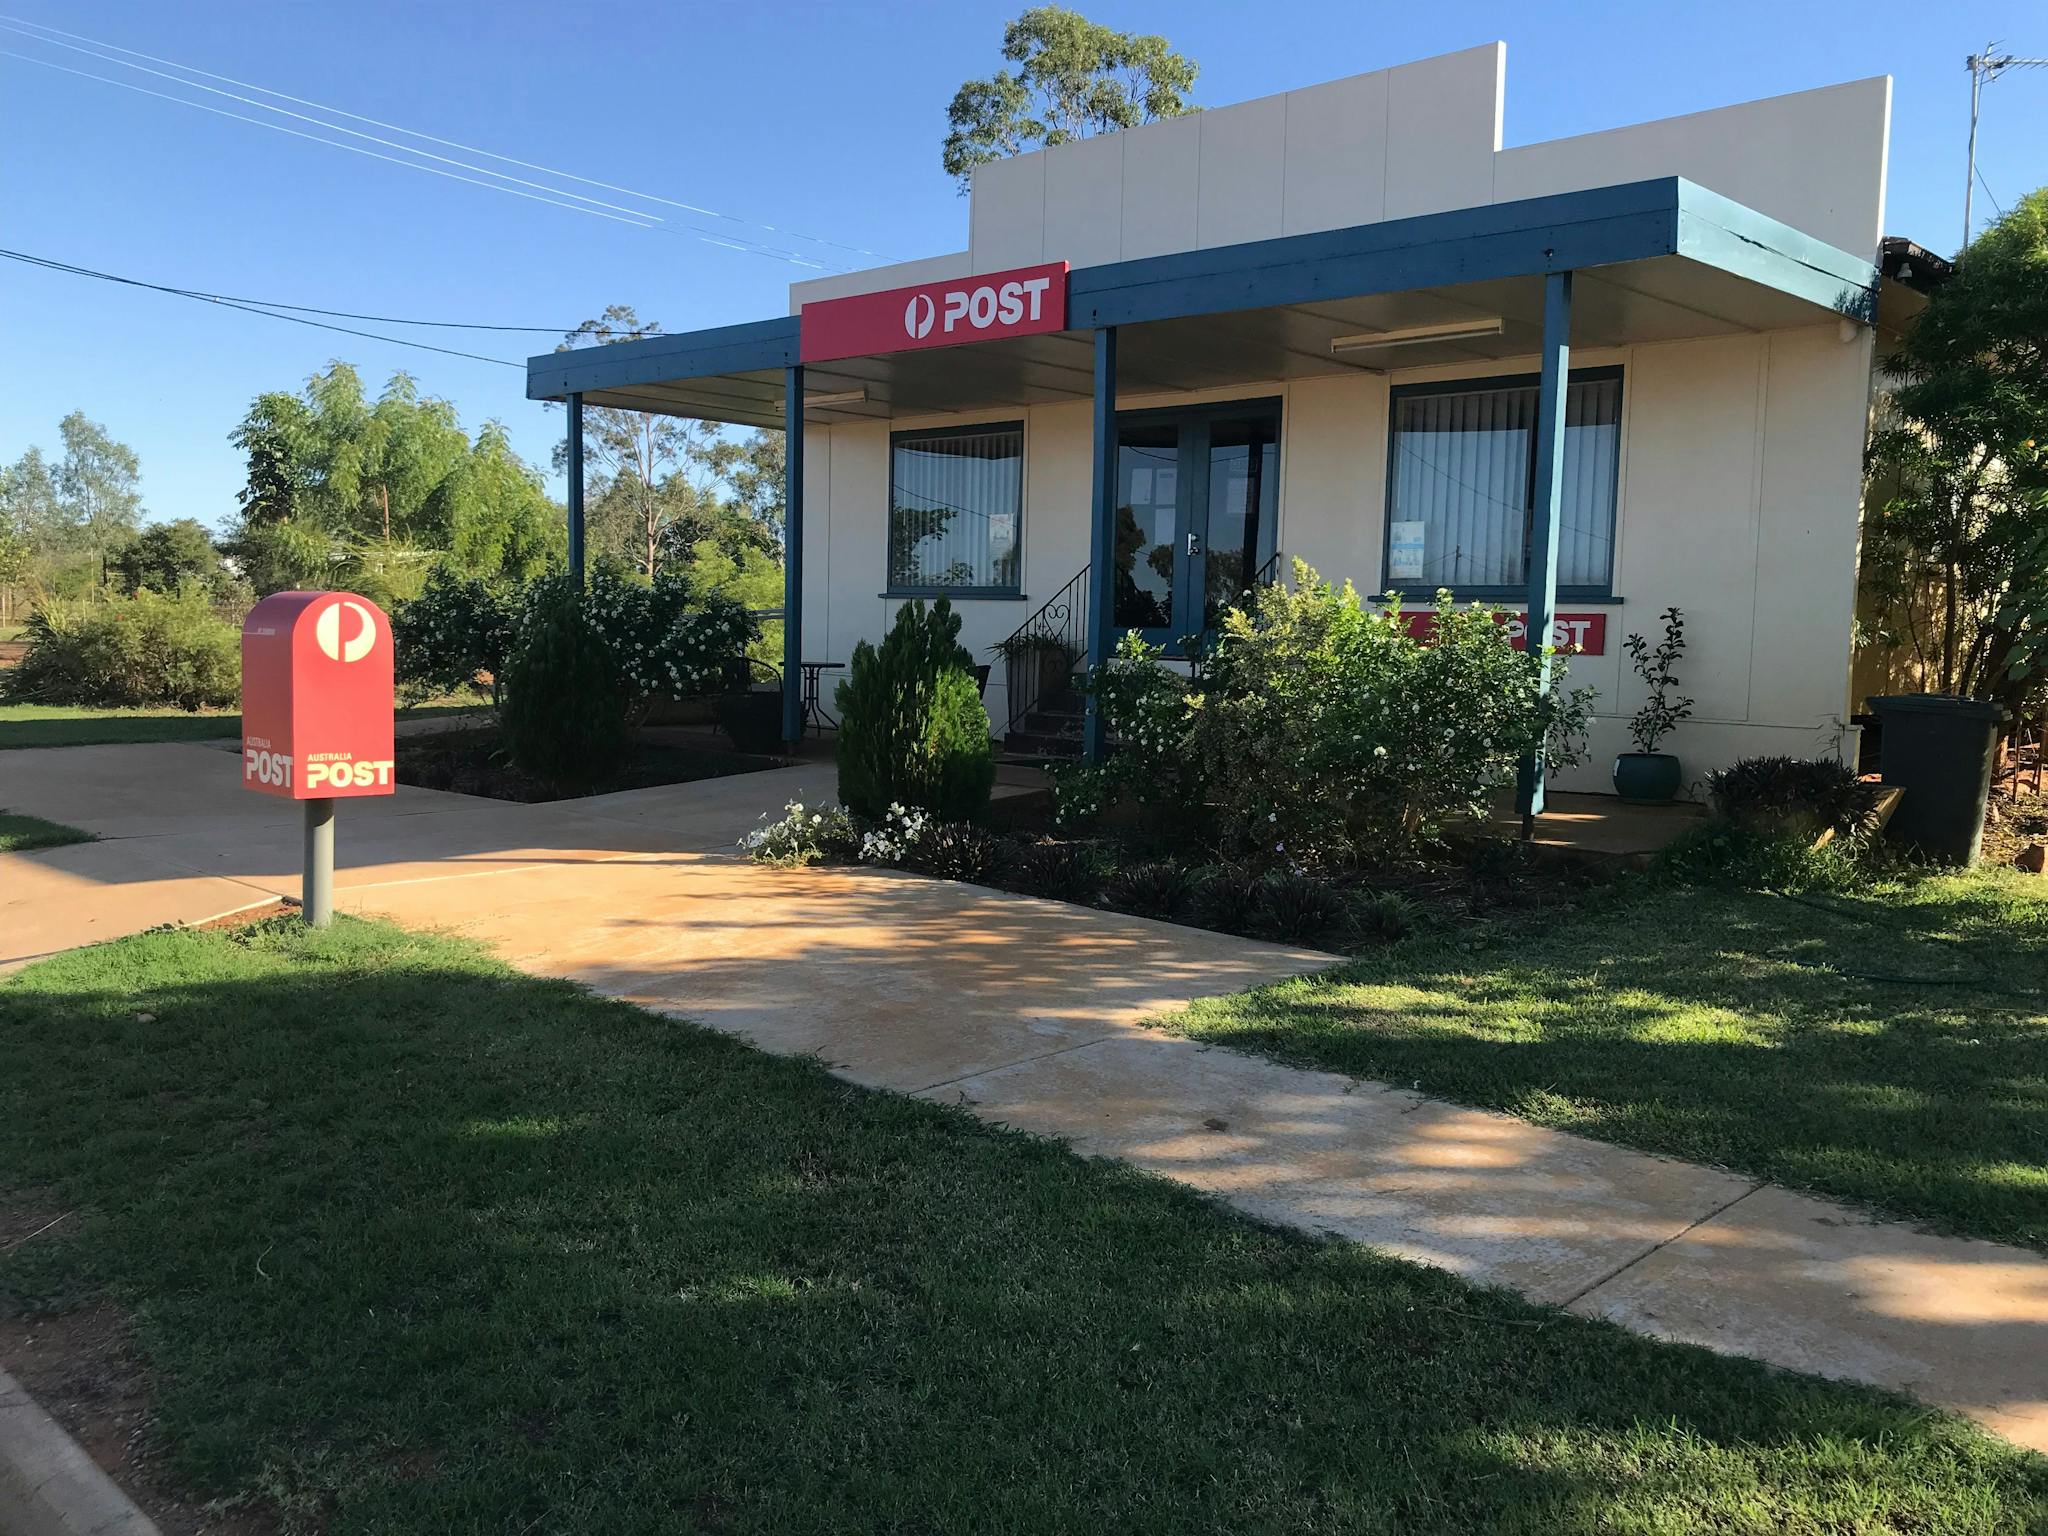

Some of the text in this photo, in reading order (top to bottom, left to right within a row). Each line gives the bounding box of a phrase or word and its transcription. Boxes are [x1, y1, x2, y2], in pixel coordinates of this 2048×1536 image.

[944, 277, 1049, 332] POST
[1507, 620, 1591, 649] PST
[246, 736, 271, 748] AUSTRALIA
[246, 749, 293, 788] POST
[307, 752, 352, 761] AUSTRALIA
[307, 760, 394, 788] POST
